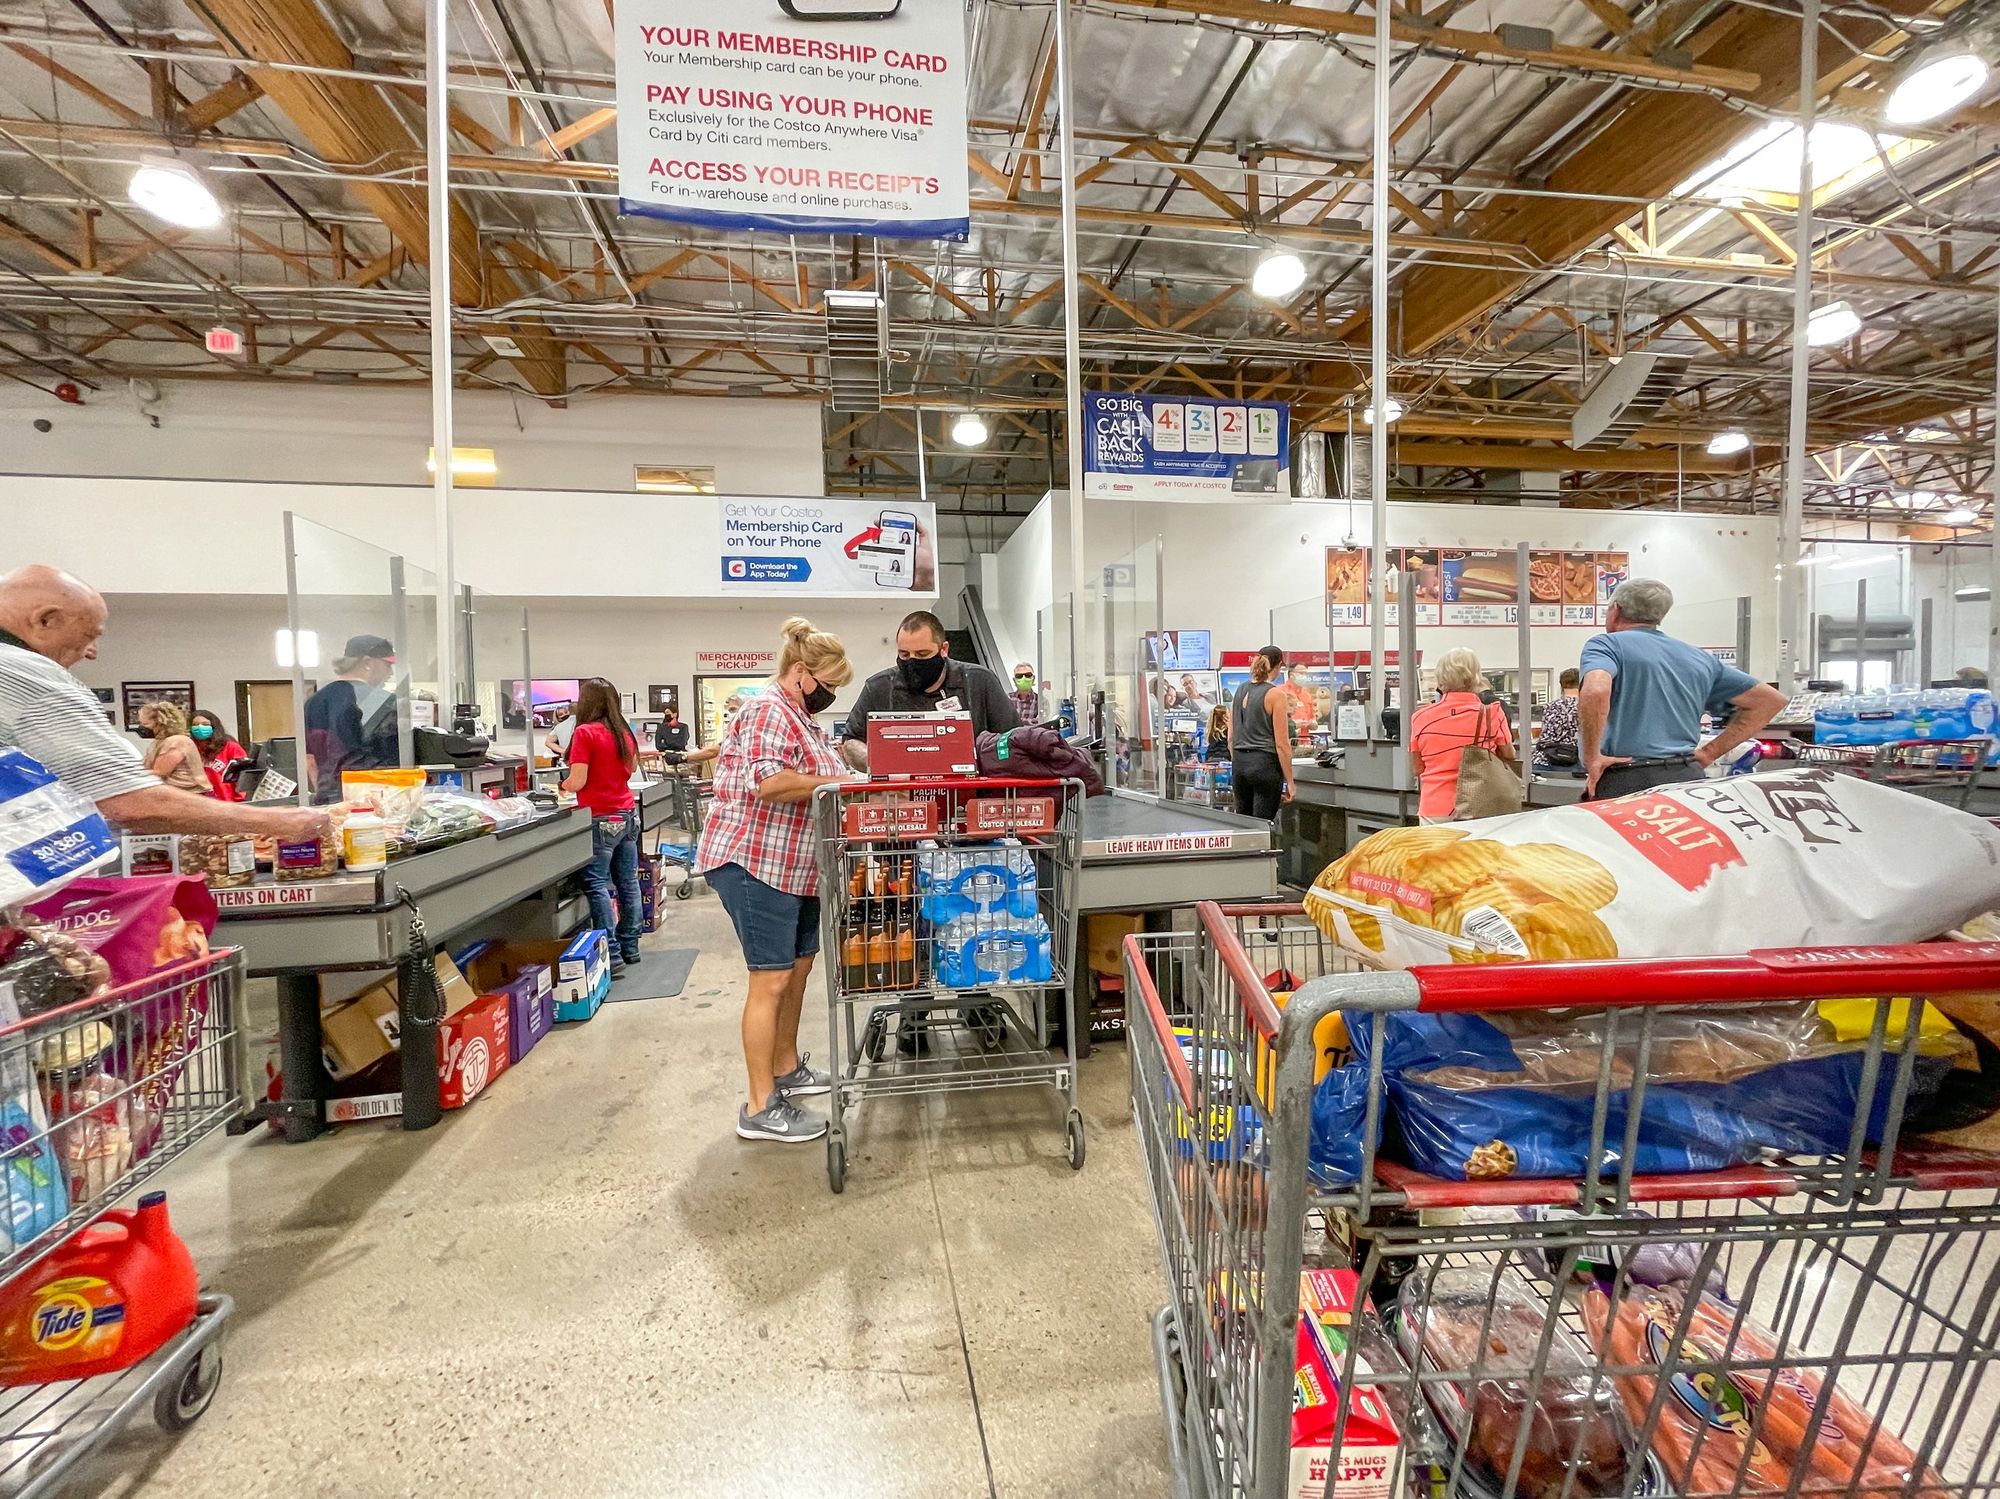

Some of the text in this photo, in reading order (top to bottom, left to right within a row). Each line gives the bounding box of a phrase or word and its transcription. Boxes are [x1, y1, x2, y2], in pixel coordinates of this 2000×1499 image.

[640, 25, 948, 73] YOUR MEMBERSHIP CARD
[643, 50, 923, 88] Your Membership card can be your phone.
[646, 85, 933, 126] PAY USING YOUR PHONE
[648, 109, 723, 127] Exclusively
[727, 114, 745, 127] for
[748, 116, 770, 129] the
[773, 118, 821, 133] Costco
[824, 122, 888, 139] Anywhere
[648, 127, 832, 152] Card by Citi card members.
[648, 158, 939, 194] ACCESS YOUR RECEIPTS
[651, 182, 913, 211] For in-warehouse and online purchases.
[211, 337, 235, 350] EXIT
[1096, 398, 1143, 412] GO BIG
[1097, 417, 1143, 436] CASH
[1097, 434, 1143, 453] BACK
[1097, 450, 1144, 463] REWARDS
[725, 504, 823, 518] Get Your Costco
[726, 519, 843, 534] Membership Card
[727, 536, 822, 549] on Your Phone
[750, 562, 798, 571] Download the
[750, 570, 790, 579] App Today!
[1347, 606, 1362, 619] 1.49
[1580, 607, 1594, 619] 2.99
[699, 652, 774, 661] MERCHANDISE
[716, 661, 758, 670] PICK-UP
[978, 820, 1005, 829] COSTCO
[1635, 804, 1723, 851] SALT
[1107, 836, 1231, 853] LEAVE HEAVY ITEMS ON CART
[257, 889, 276, 904] ON
[279, 888, 313, 903] CART
[74, 909, 111, 929] DOG
[354, 1100, 389, 1117] GOLDEN
[37, 1306, 87, 1343] Tide
[1310, 1455, 1387, 1467] MAES MUGS
